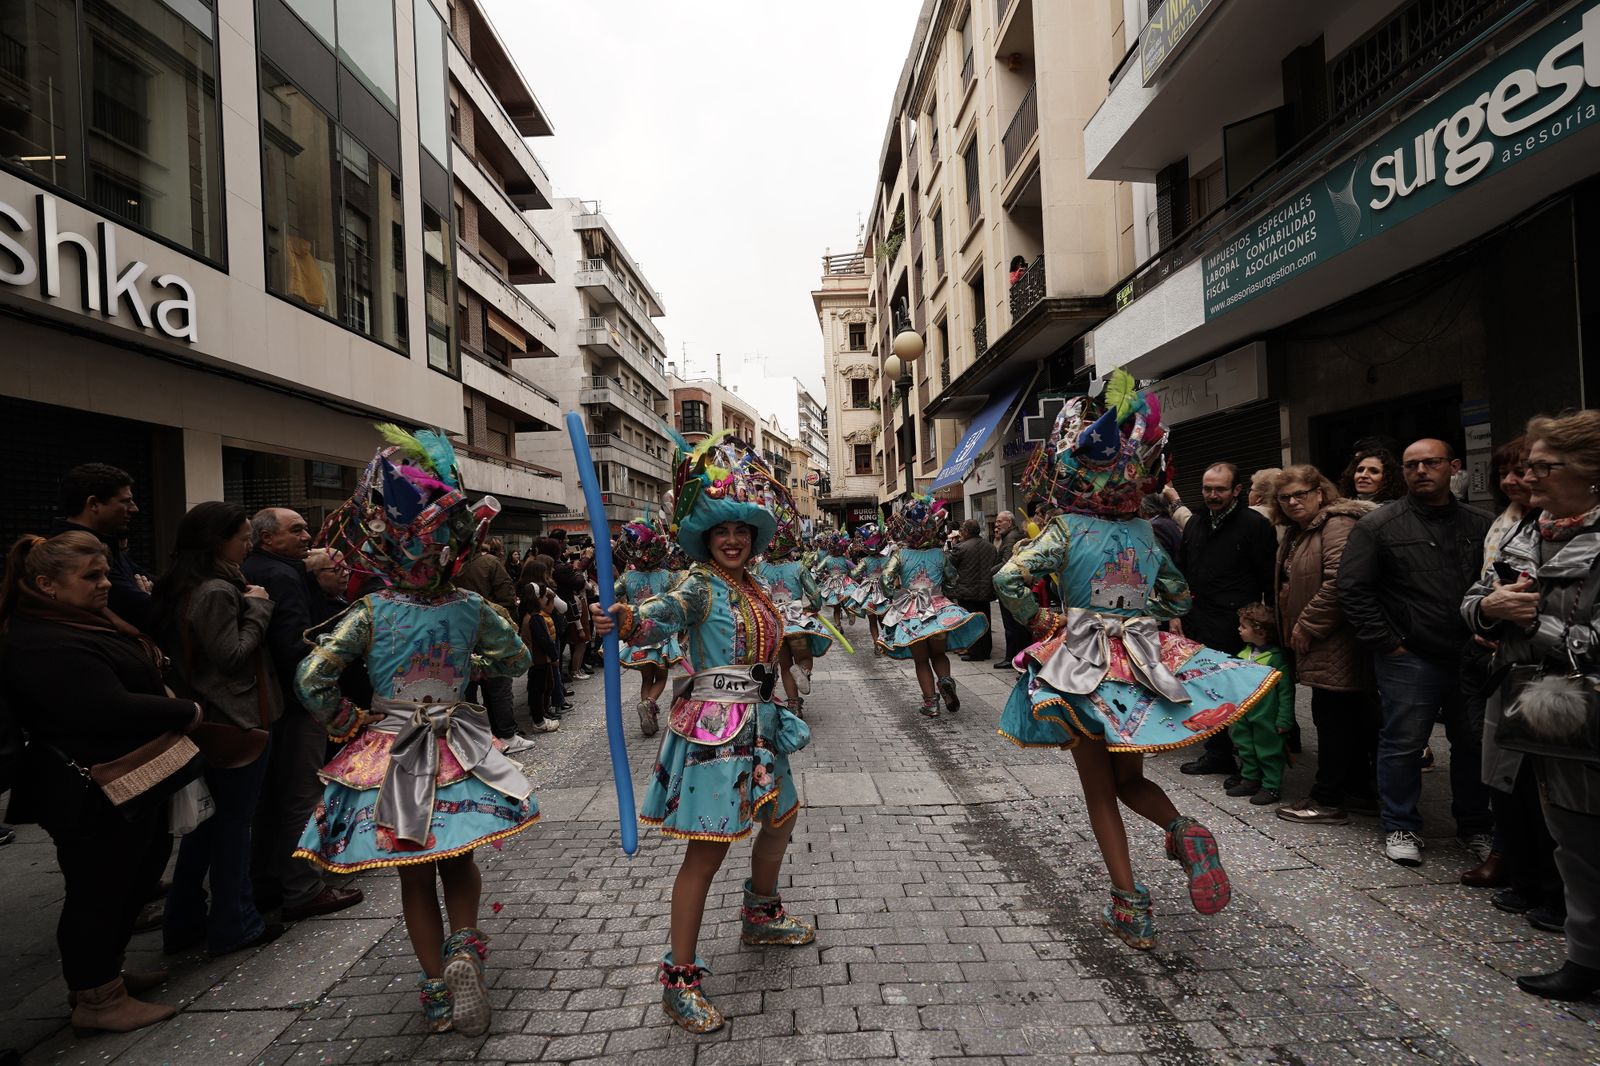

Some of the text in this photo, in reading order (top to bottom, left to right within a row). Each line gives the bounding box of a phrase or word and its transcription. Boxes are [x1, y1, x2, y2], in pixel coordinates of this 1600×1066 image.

[1168, 4, 1197, 47] VENTA
[1502, 103, 1596, 163] asesoría
[1206, 209, 1316, 286] LABORAL CONTABILIDAD
[1206, 226, 1317, 300] FISCAL ASOCIACIONES
[1207, 193, 1312, 270] IMPUESTOS ESPECIALES
[1209, 250, 1317, 314] www.asesoriasurgestion.com
